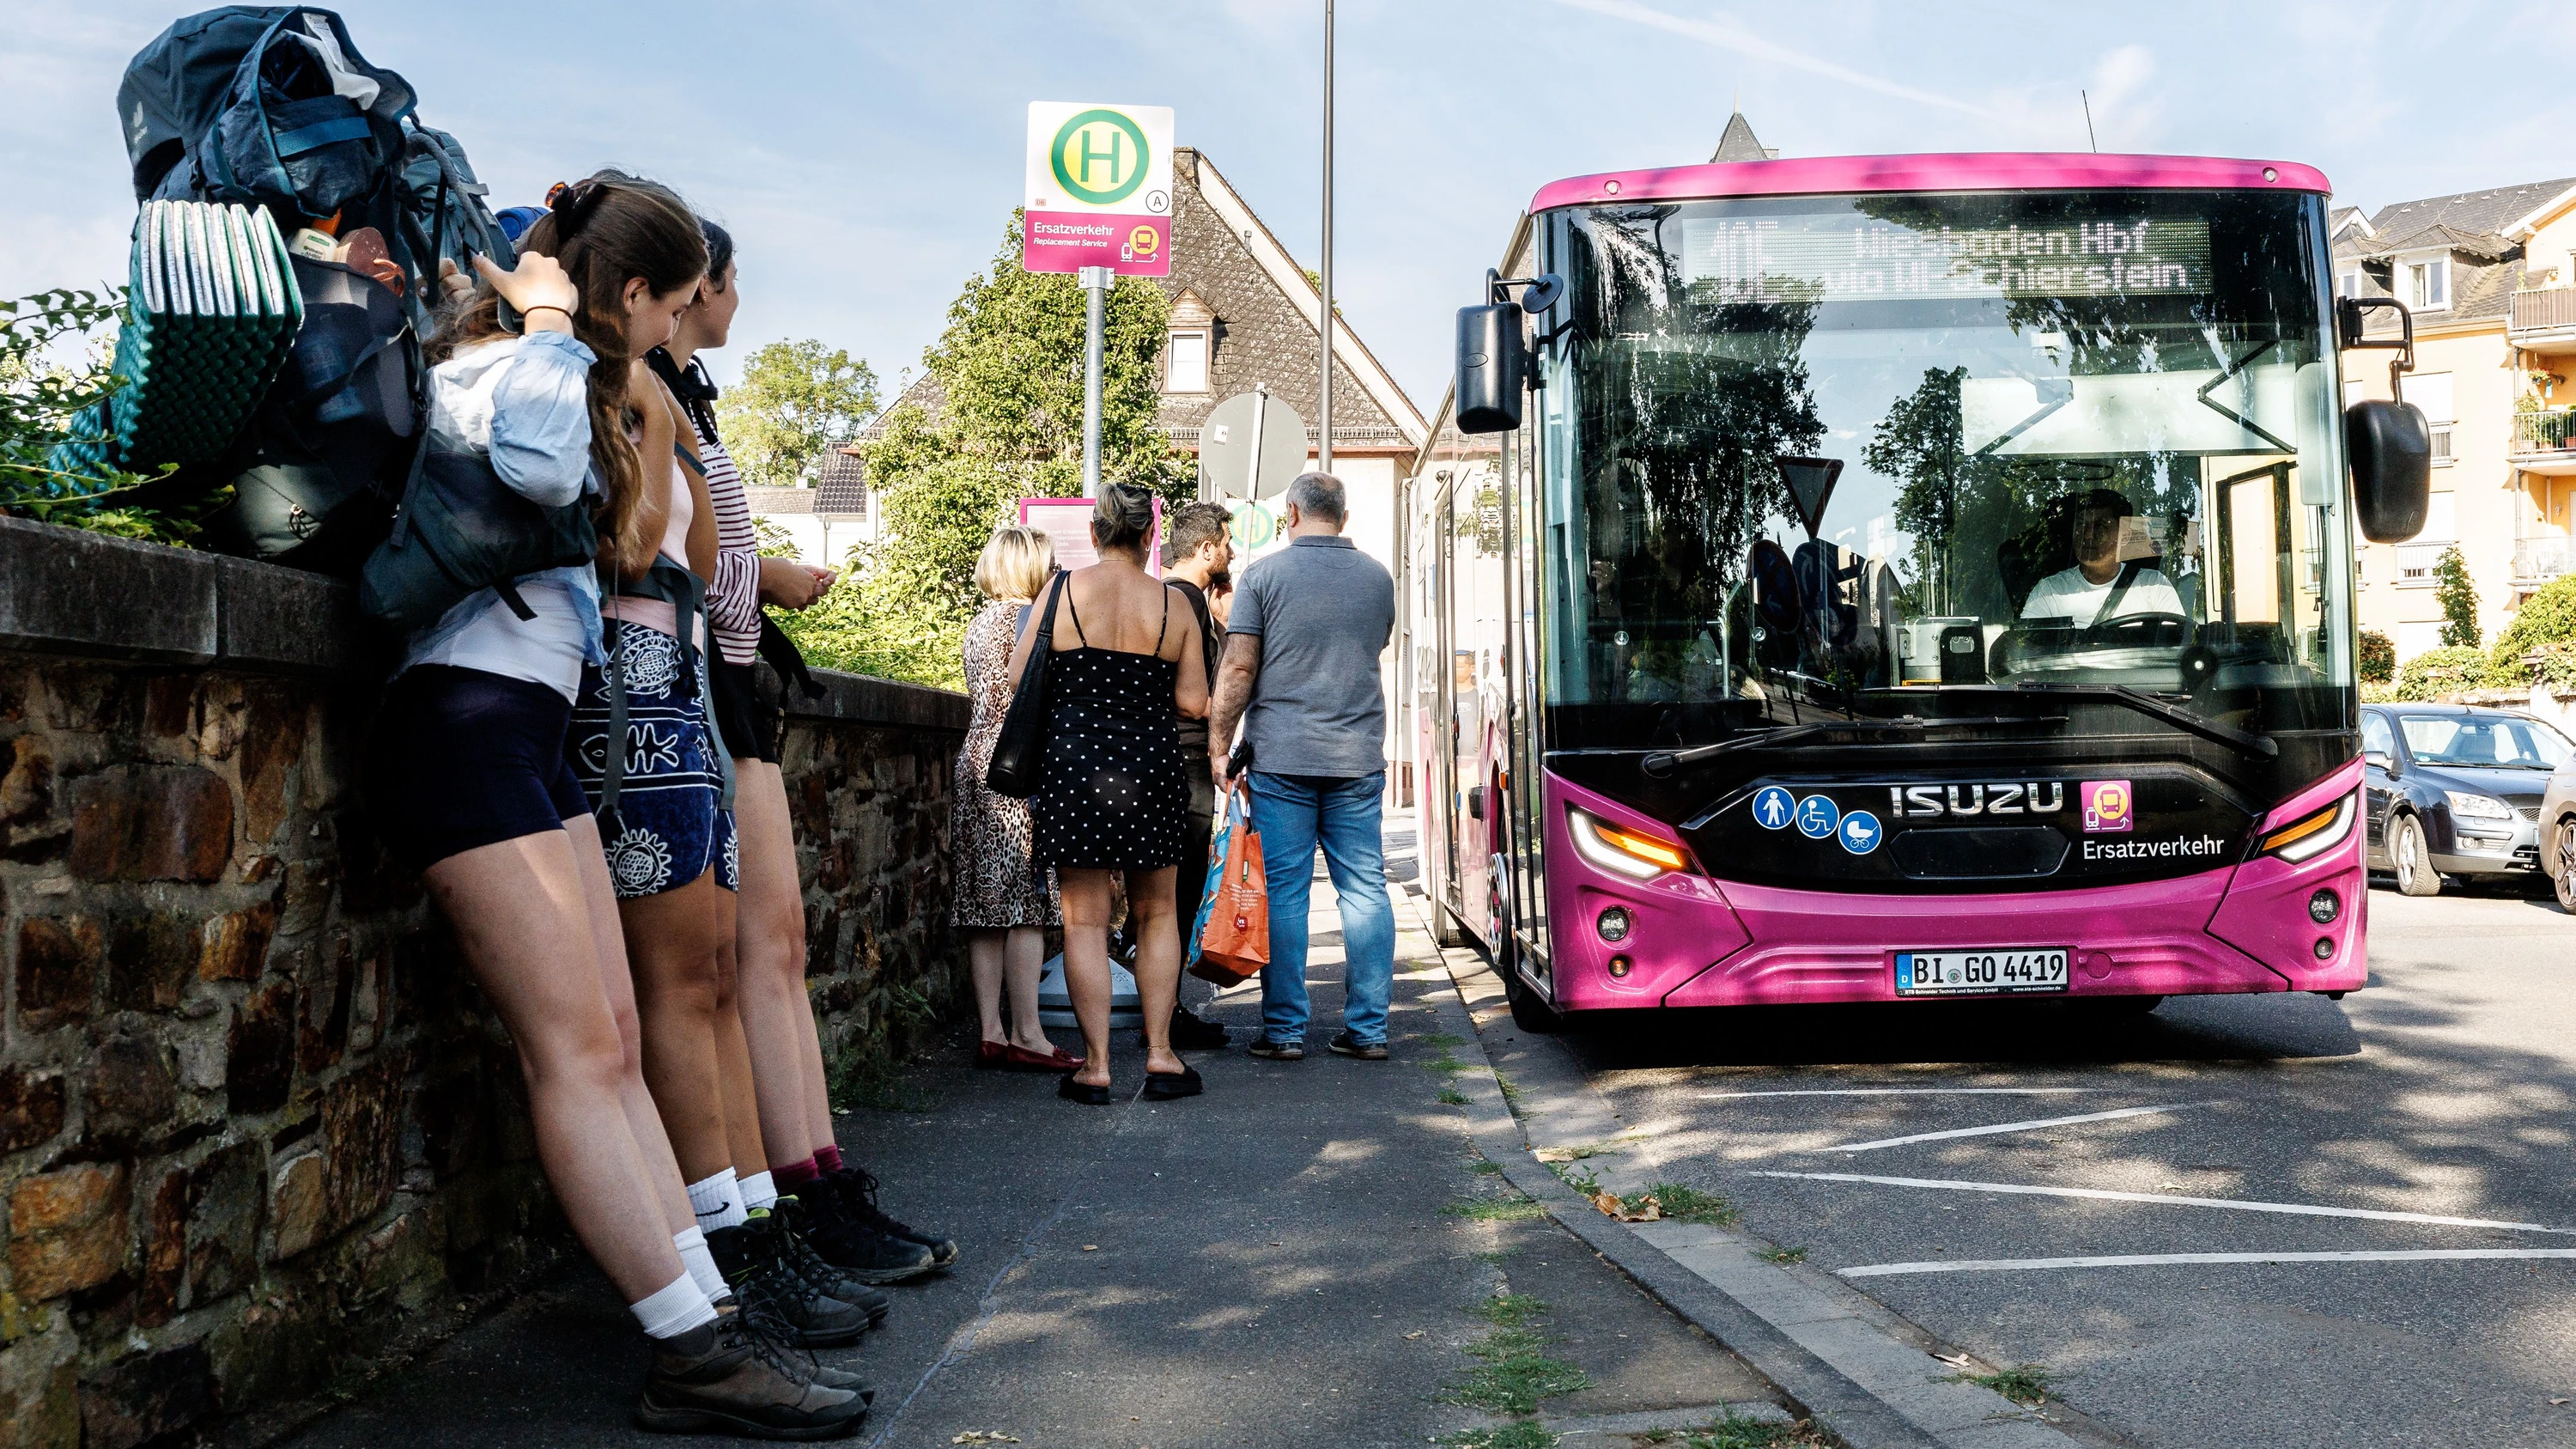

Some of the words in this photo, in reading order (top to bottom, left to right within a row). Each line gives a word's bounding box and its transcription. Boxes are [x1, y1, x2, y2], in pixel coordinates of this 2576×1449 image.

[1080, 131, 1121, 184] H
[1153, 197, 1162, 207] A
[1033, 237, 1080, 247] Replacement
[1034, 222, 1115, 236] Ersatzverkehr
[1855, 224, 2069, 258] Wiesbaden
[2081, 221, 2149, 254] Hbf
[1890, 782, 2063, 818] ISUZU
[2083, 834, 2225, 860] Ersatzverkehr
[1901, 975, 1909, 984] D
[1913, 957, 1944, 984] BI
[1965, 955, 1996, 983] GO
[2003, 954, 2064, 982] 4419
